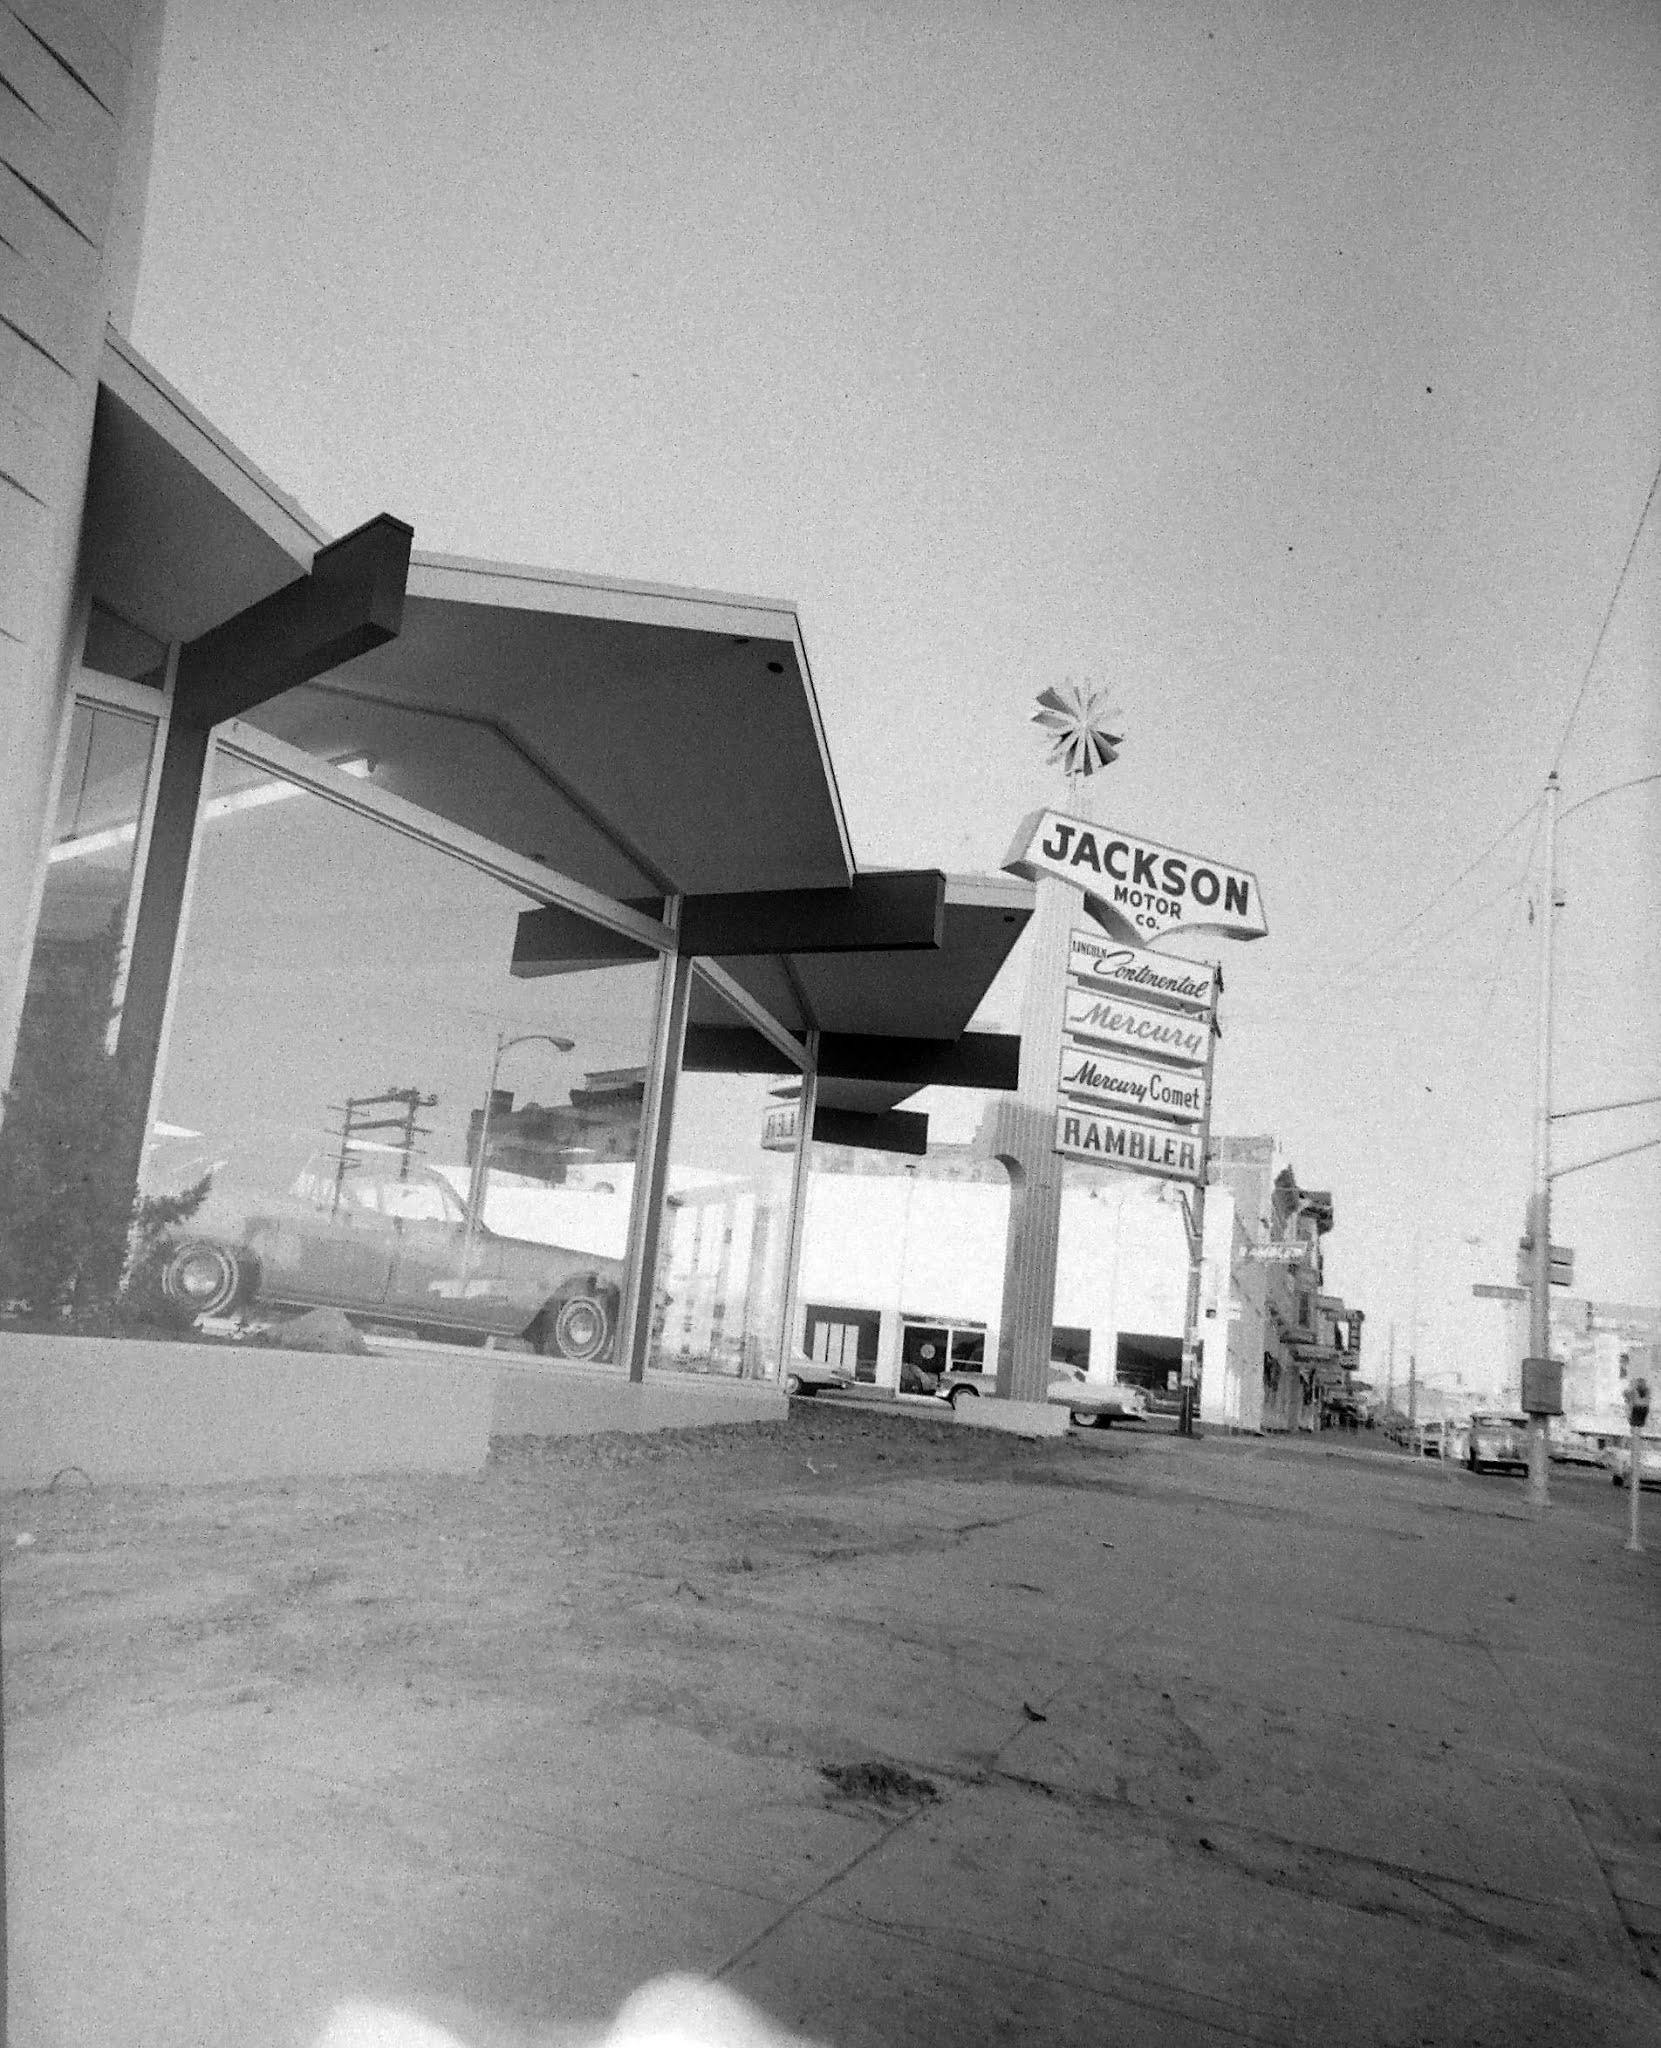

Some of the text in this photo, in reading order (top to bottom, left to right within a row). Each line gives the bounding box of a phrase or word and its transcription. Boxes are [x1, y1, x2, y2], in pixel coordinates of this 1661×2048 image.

[1043, 823, 1249, 916] JACKSON
[1114, 884, 1182, 919] MOTOR
[1072, 940, 1210, 999] LINCOLN Continental
[1069, 1002, 1202, 1054] Mercury
[1062, 1060, 1200, 1110] Mercury Comet
[1063, 1117, 1195, 1170] RAMBLER
